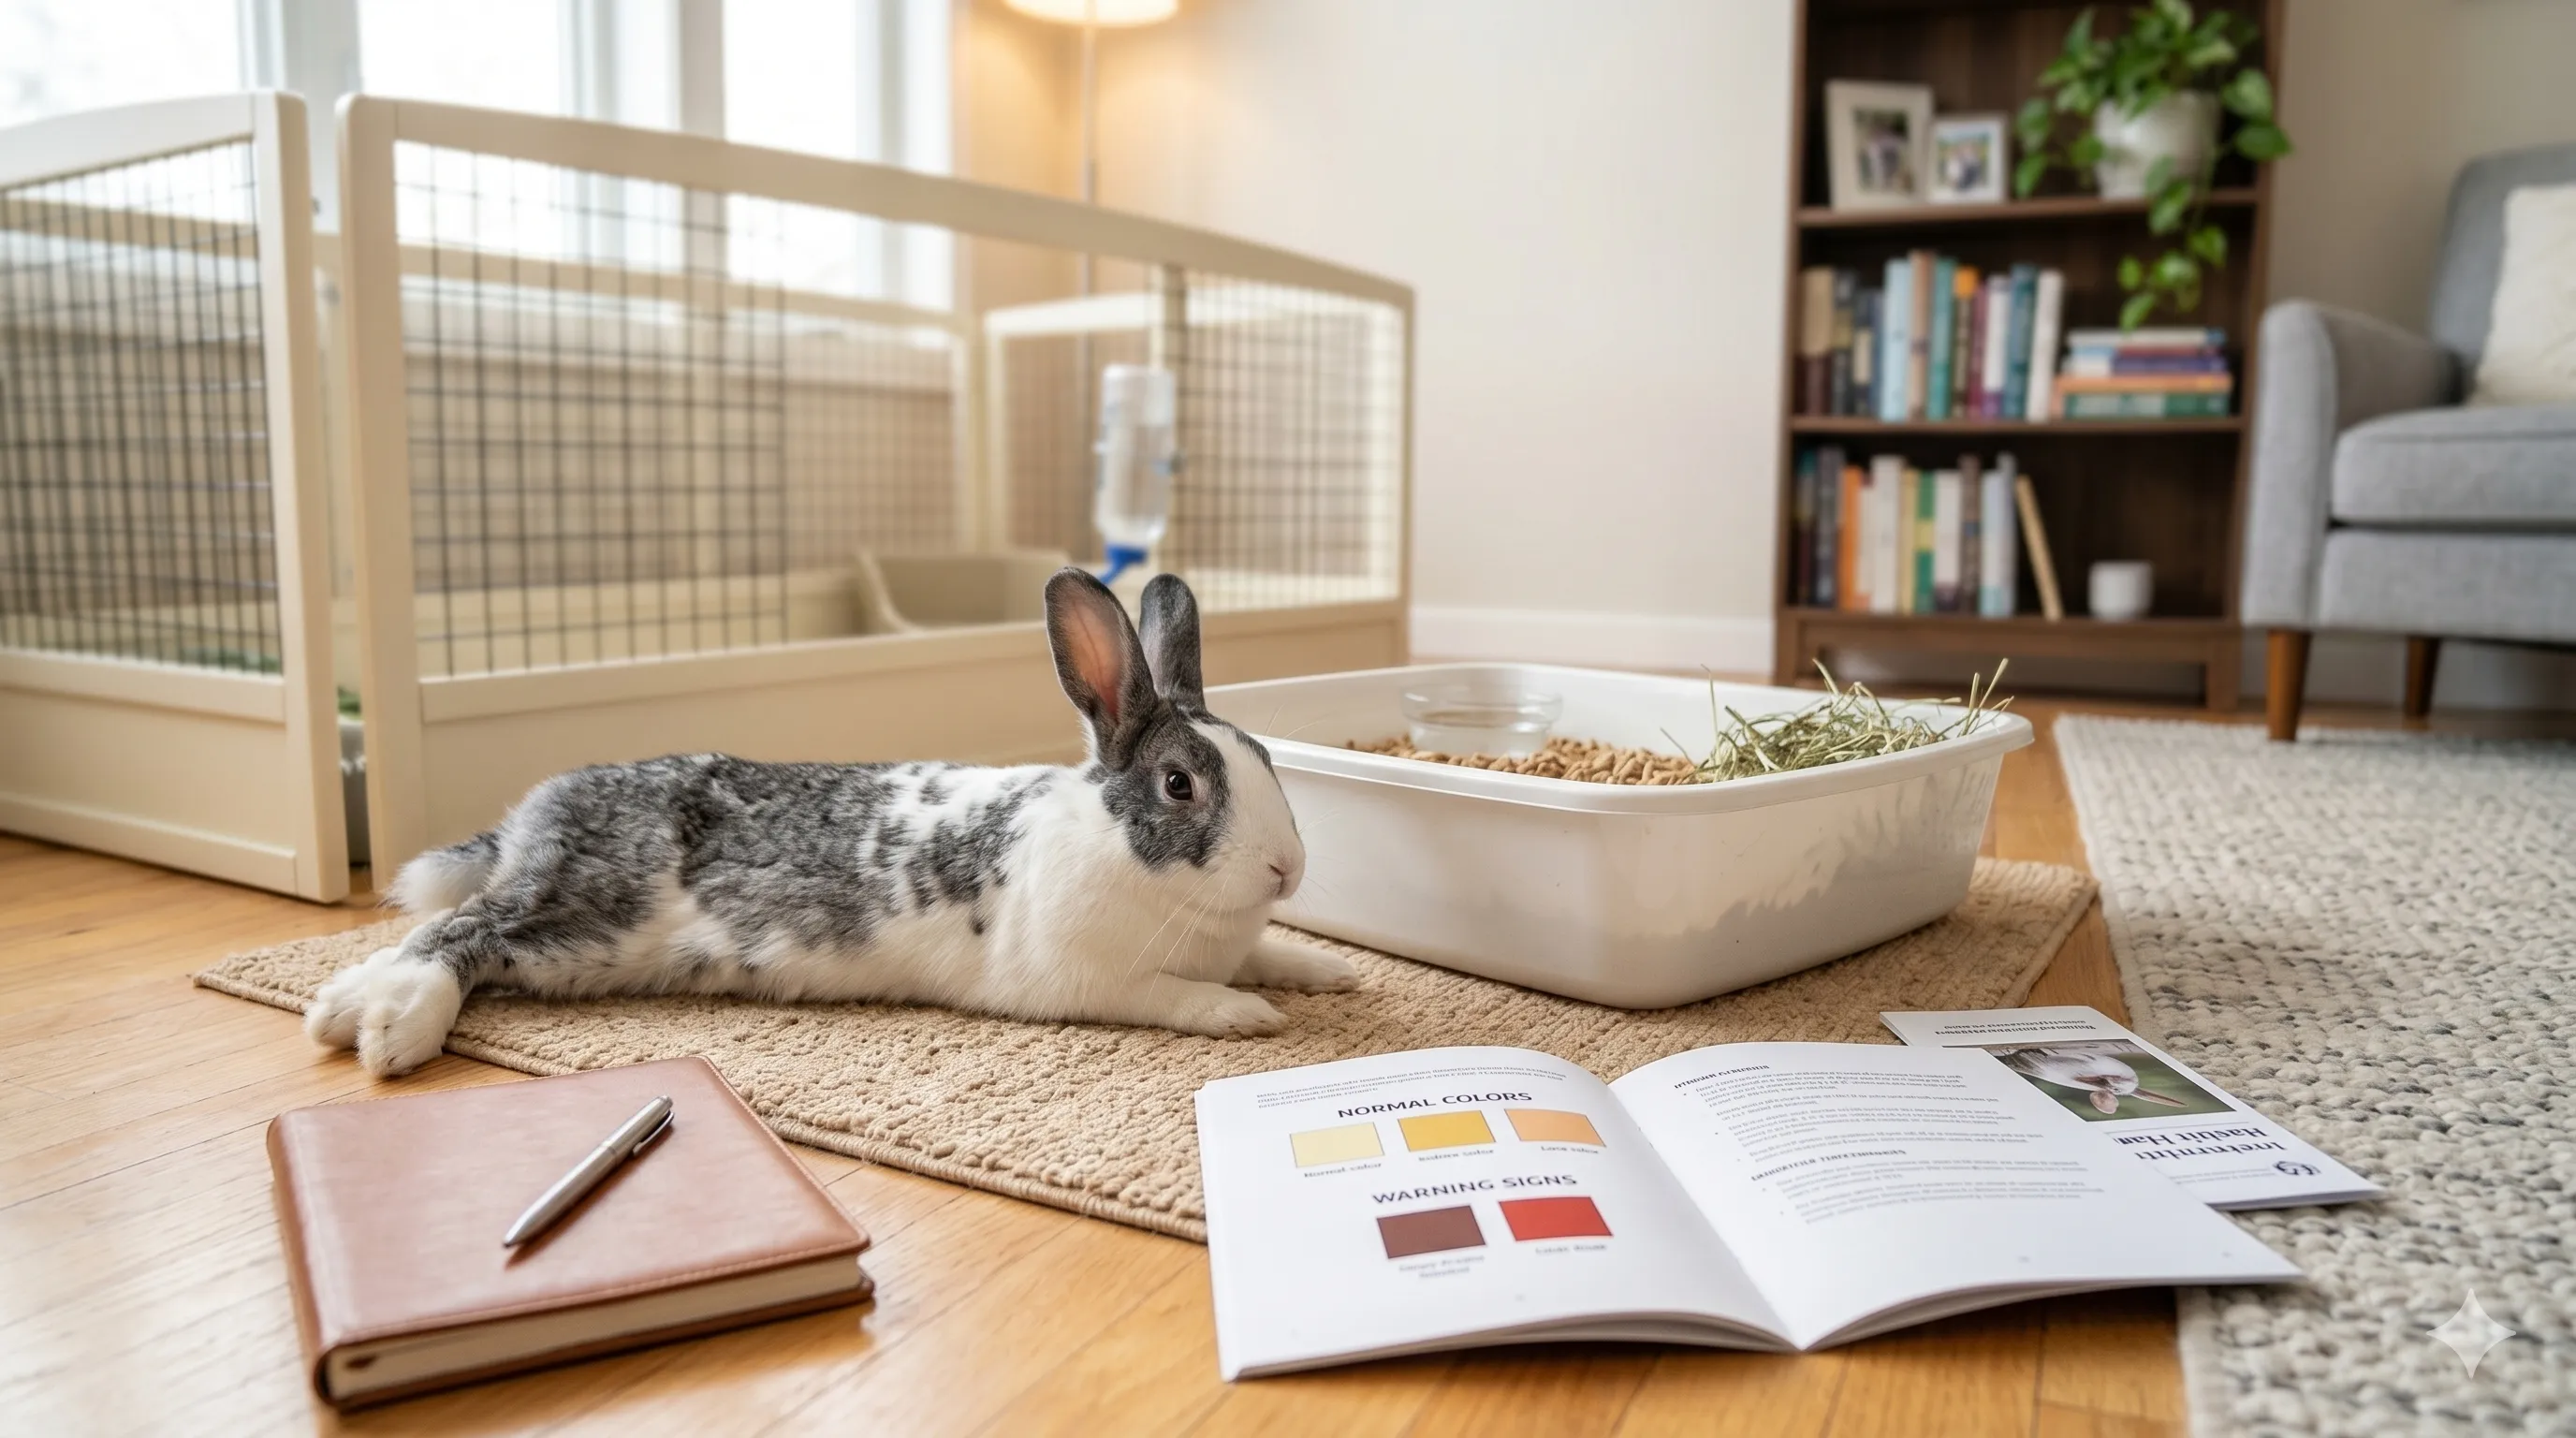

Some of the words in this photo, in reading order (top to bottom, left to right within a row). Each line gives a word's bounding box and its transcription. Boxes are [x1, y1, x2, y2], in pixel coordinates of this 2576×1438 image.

[1338, 1098, 1436, 1118] NORMAL
[1442, 1093, 1532, 1105] COLORS
[1372, 1180, 1495, 1204] WARNING
[1501, 1174, 1578, 1188] SIGNS
